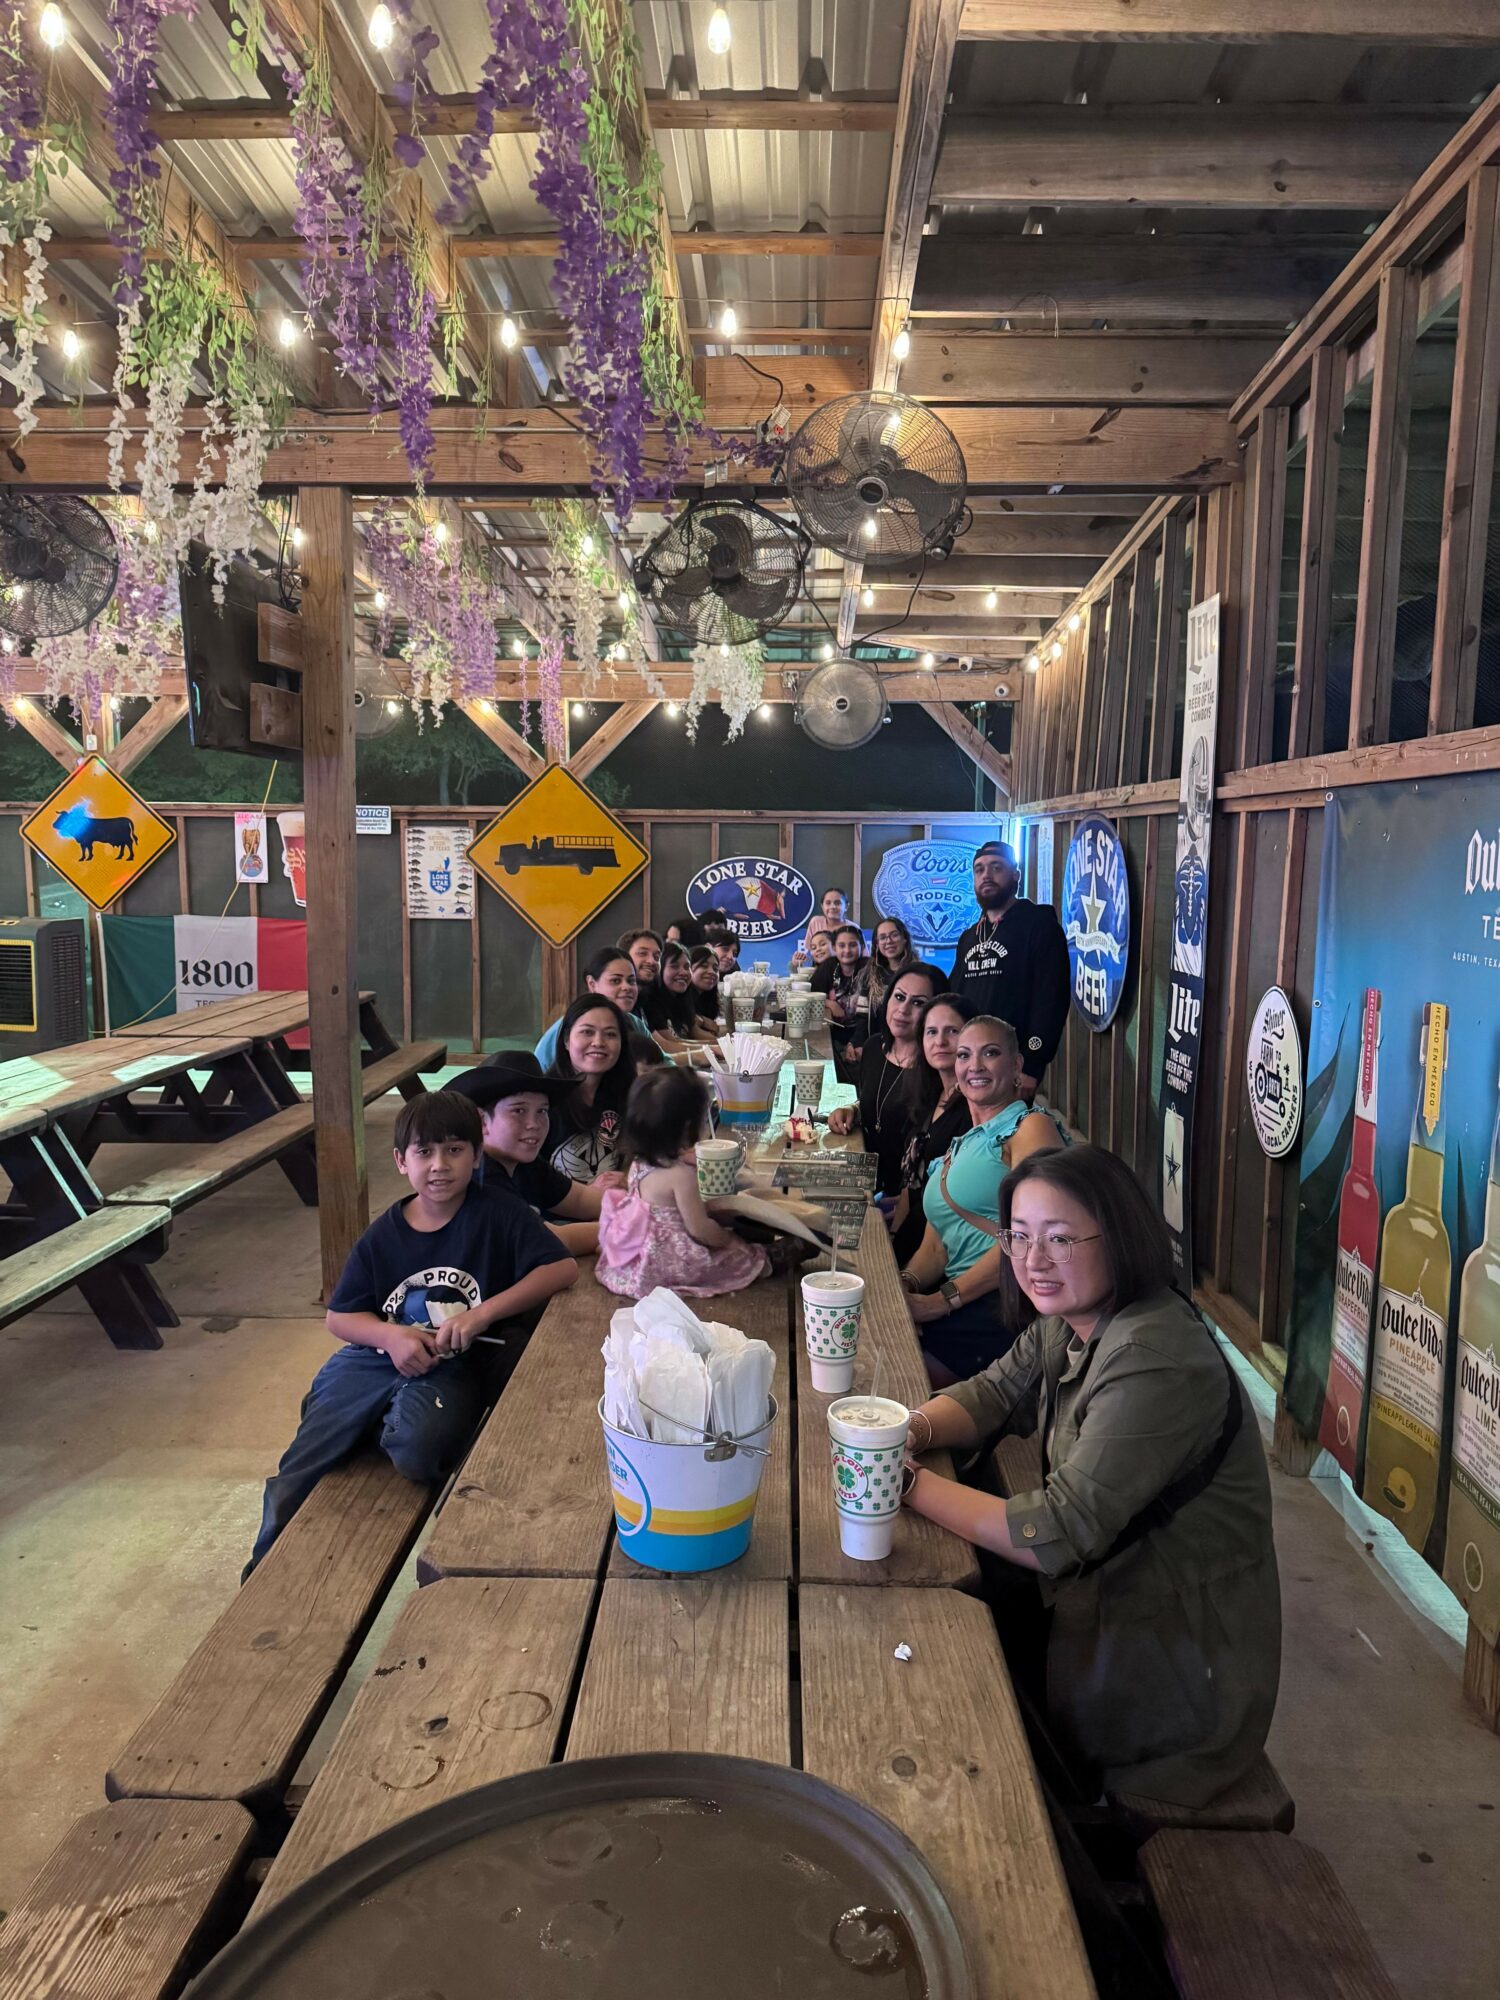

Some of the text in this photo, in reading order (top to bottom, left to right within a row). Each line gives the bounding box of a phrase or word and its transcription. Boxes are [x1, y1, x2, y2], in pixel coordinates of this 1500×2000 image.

[1189, 613, 1217, 675] Lite
[1193, 678, 1212, 697] THE ONLY
[1188, 696, 1201, 711] BEER
[1191, 706, 1211, 723] COWBOYS
[356, 808, 388, 817] NOTICE
[912, 849, 969, 874] Coors
[695, 862, 803, 896] LONE STAR
[1064, 829, 1125, 934] LONE STAR
[915, 891, 962, 903] RODEO
[726, 918, 777, 936] BEER
[981, 957, 997, 970] CREW
[1452, 951, 1480, 965] AUSTIN,
[179, 959, 253, 989] 1800
[1075, 954, 1108, 1017] BEER
[1168, 982, 1200, 1043] Lite
[1433, 1006, 1442, 1044] HECHO
[1170, 1047, 1191, 1068] THE ONLY
[1276, 1050, 1282, 1062] TO
[1432, 1048, 1438, 1062] EN
[1165, 1058, 1193, 1083] BEER OF THE
[1167, 1073, 1188, 1094] COWBOYS
[1264, 1134, 1282, 1148] LOCAL
[1281, 1084, 1298, 1140] FARMERS
[423, 1270, 478, 1301] PROUD
[835, 1317, 846, 1329] BIG
[1381, 1299, 1419, 1343] Dulce
[1389, 1337, 1436, 1375] PINEAPPLE
[1461, 1354, 1491, 1406] Dulce
[1475, 1403, 1498, 1438] LIME
[841, 1455, 865, 1478] LOUS
[1456, 1470, 1469, 1489] REAL
